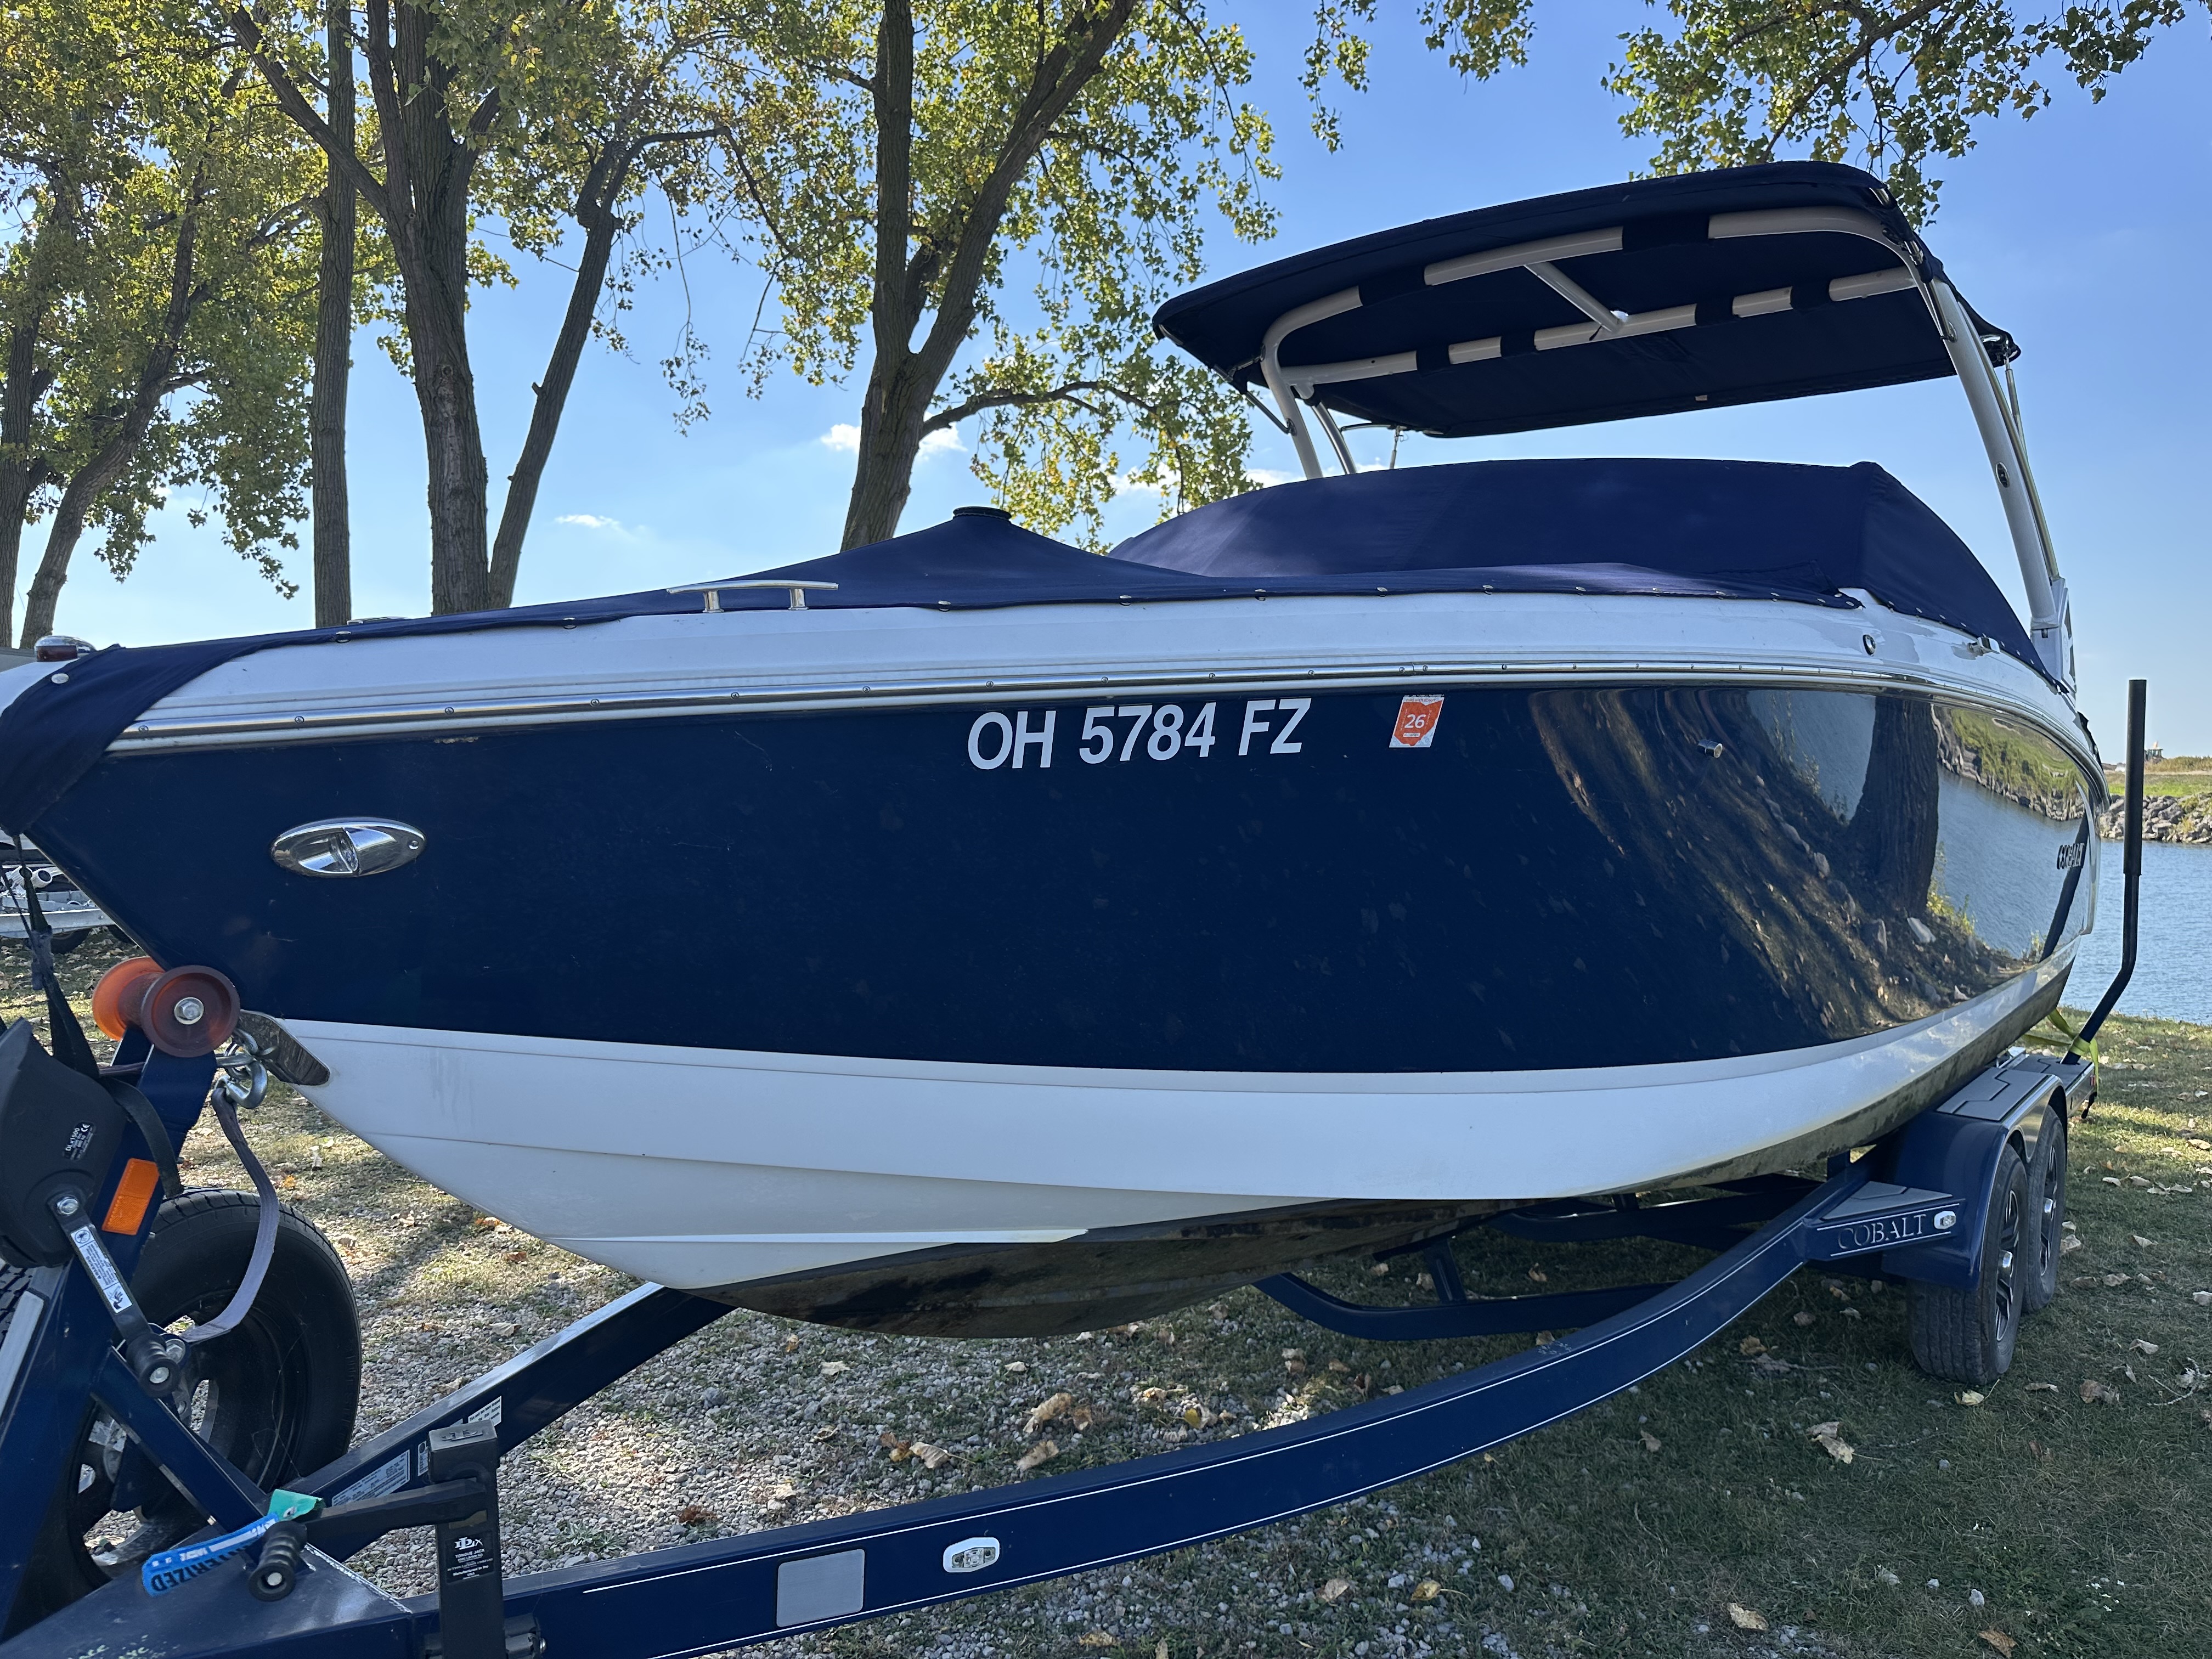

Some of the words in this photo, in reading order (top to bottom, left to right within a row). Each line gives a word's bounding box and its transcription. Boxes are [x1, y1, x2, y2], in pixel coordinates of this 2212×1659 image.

[968, 711, 1056, 769] OH
[1080, 702, 1216, 764] 5784
[1239, 698, 1311, 755] FZ
[1404, 714, 1426, 729] 26
[1838, 1214, 1927, 1249] COBALT
